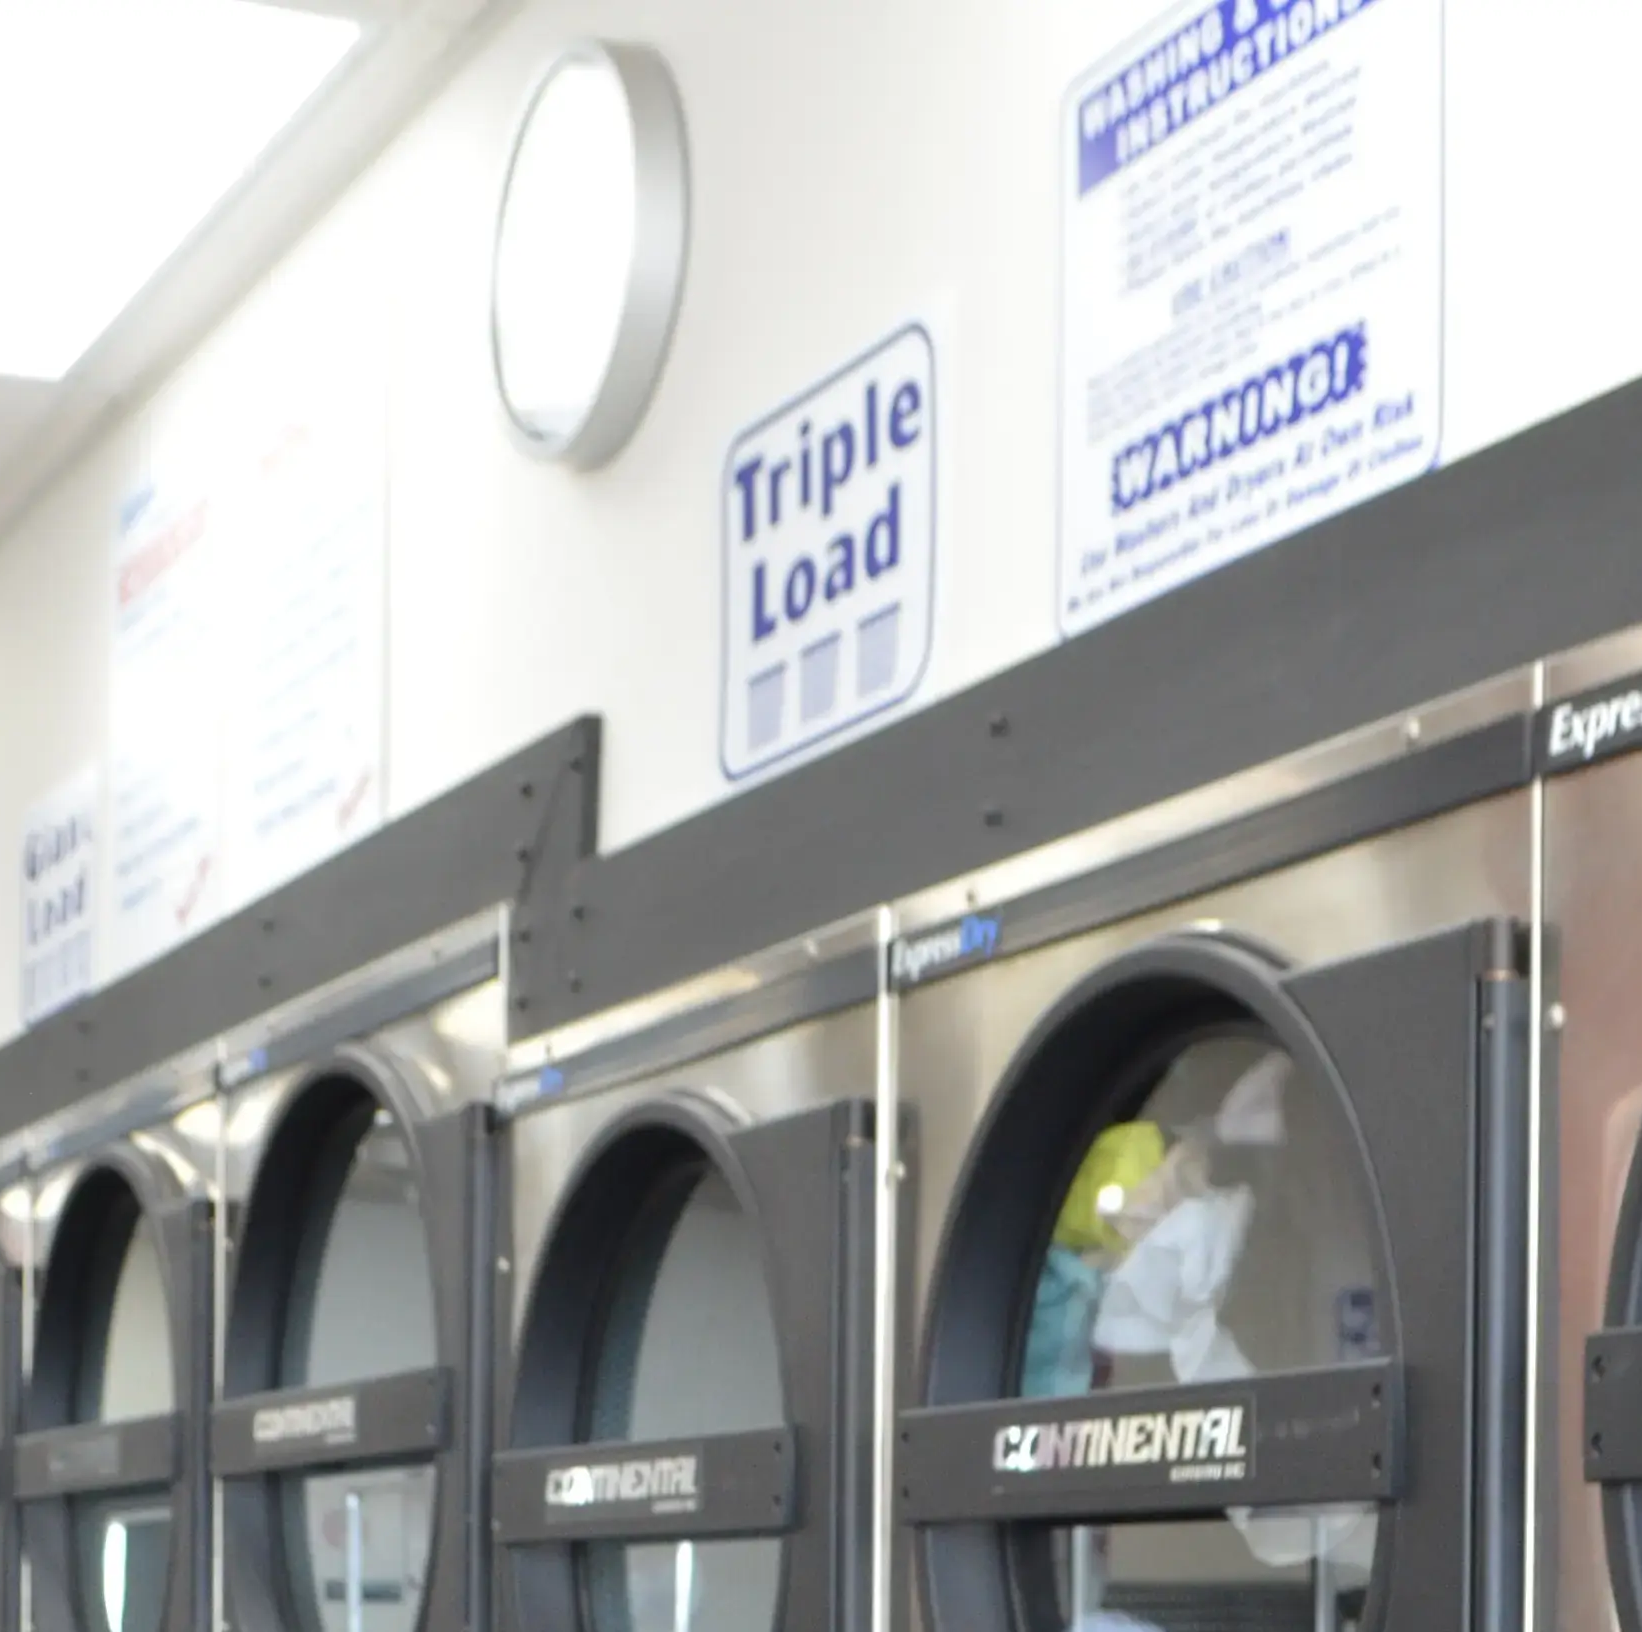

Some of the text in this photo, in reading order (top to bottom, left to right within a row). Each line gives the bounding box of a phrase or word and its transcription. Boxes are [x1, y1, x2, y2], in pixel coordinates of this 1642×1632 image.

[734, 378, 923, 544] Triple
[751, 478, 901, 644] Load
[992, 1405, 1247, 1472] CONTINENTAL
